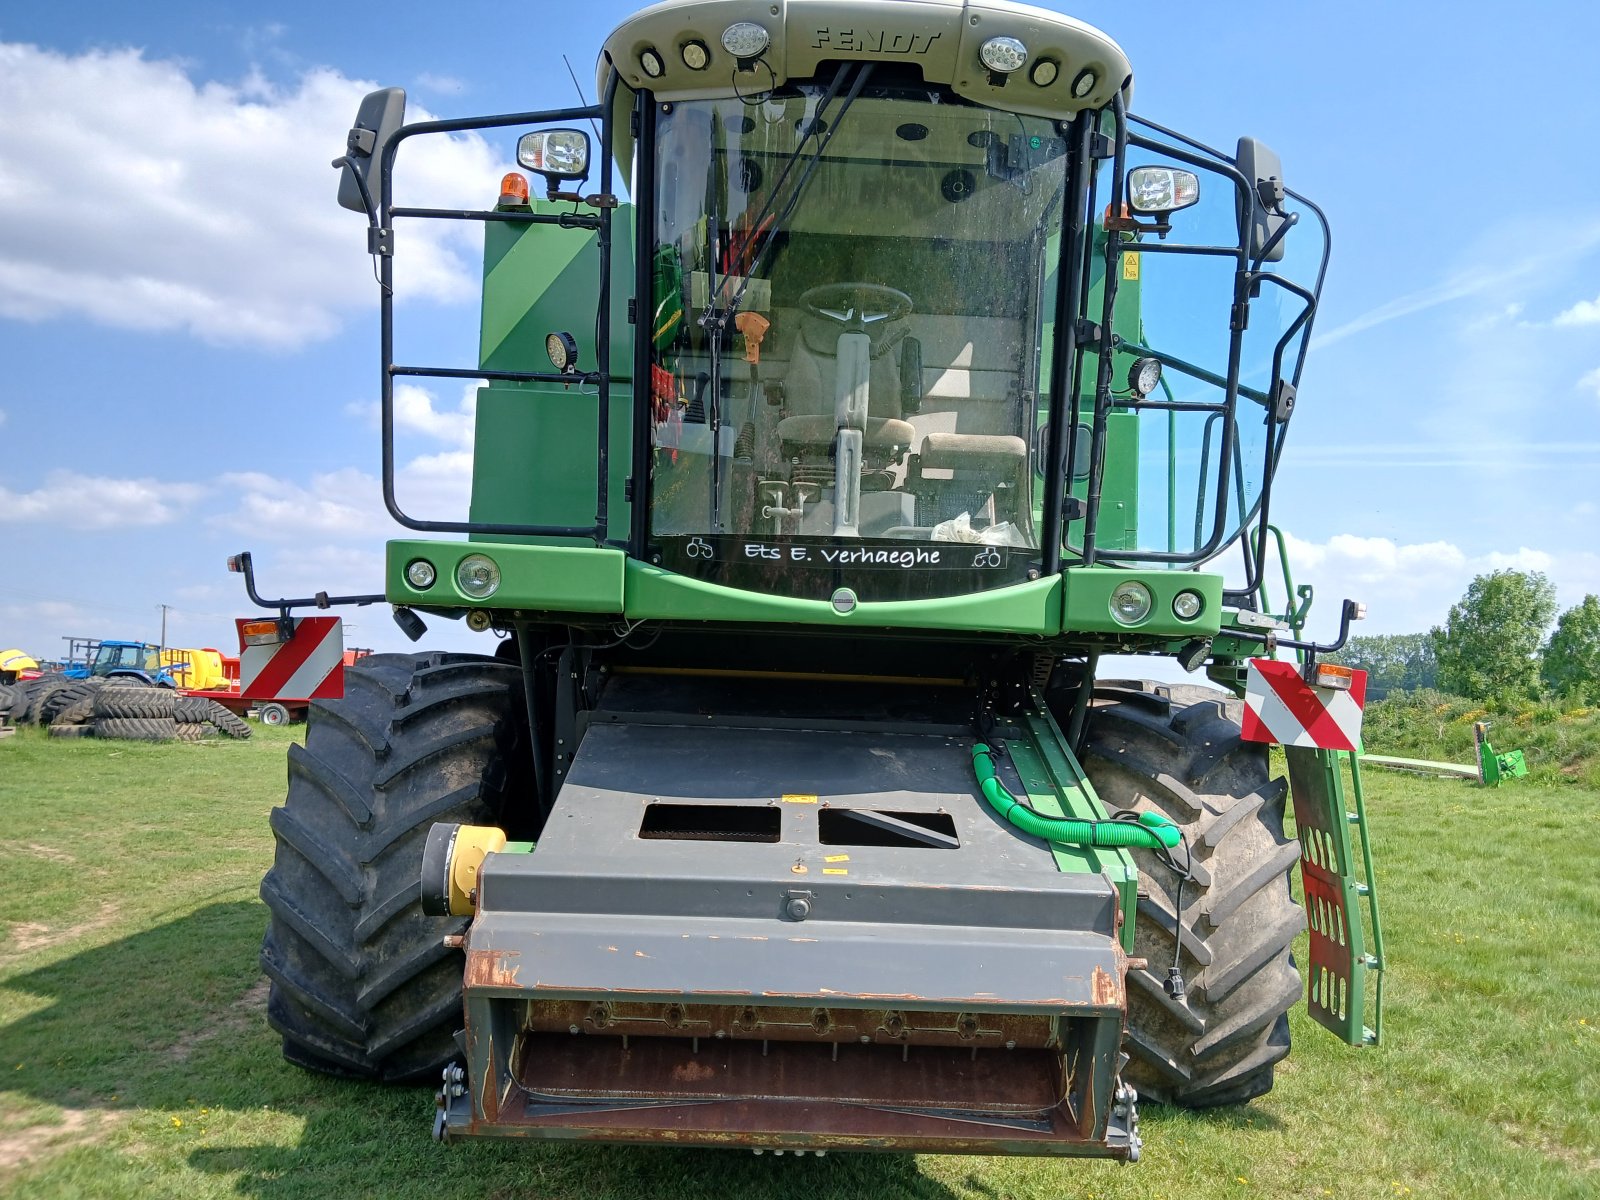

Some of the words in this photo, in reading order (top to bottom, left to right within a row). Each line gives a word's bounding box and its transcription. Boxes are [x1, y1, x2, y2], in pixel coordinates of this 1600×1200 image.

[811, 27, 942, 54] FENDT
[744, 544, 781, 560] Ets
[790, 547, 812, 561] E.
